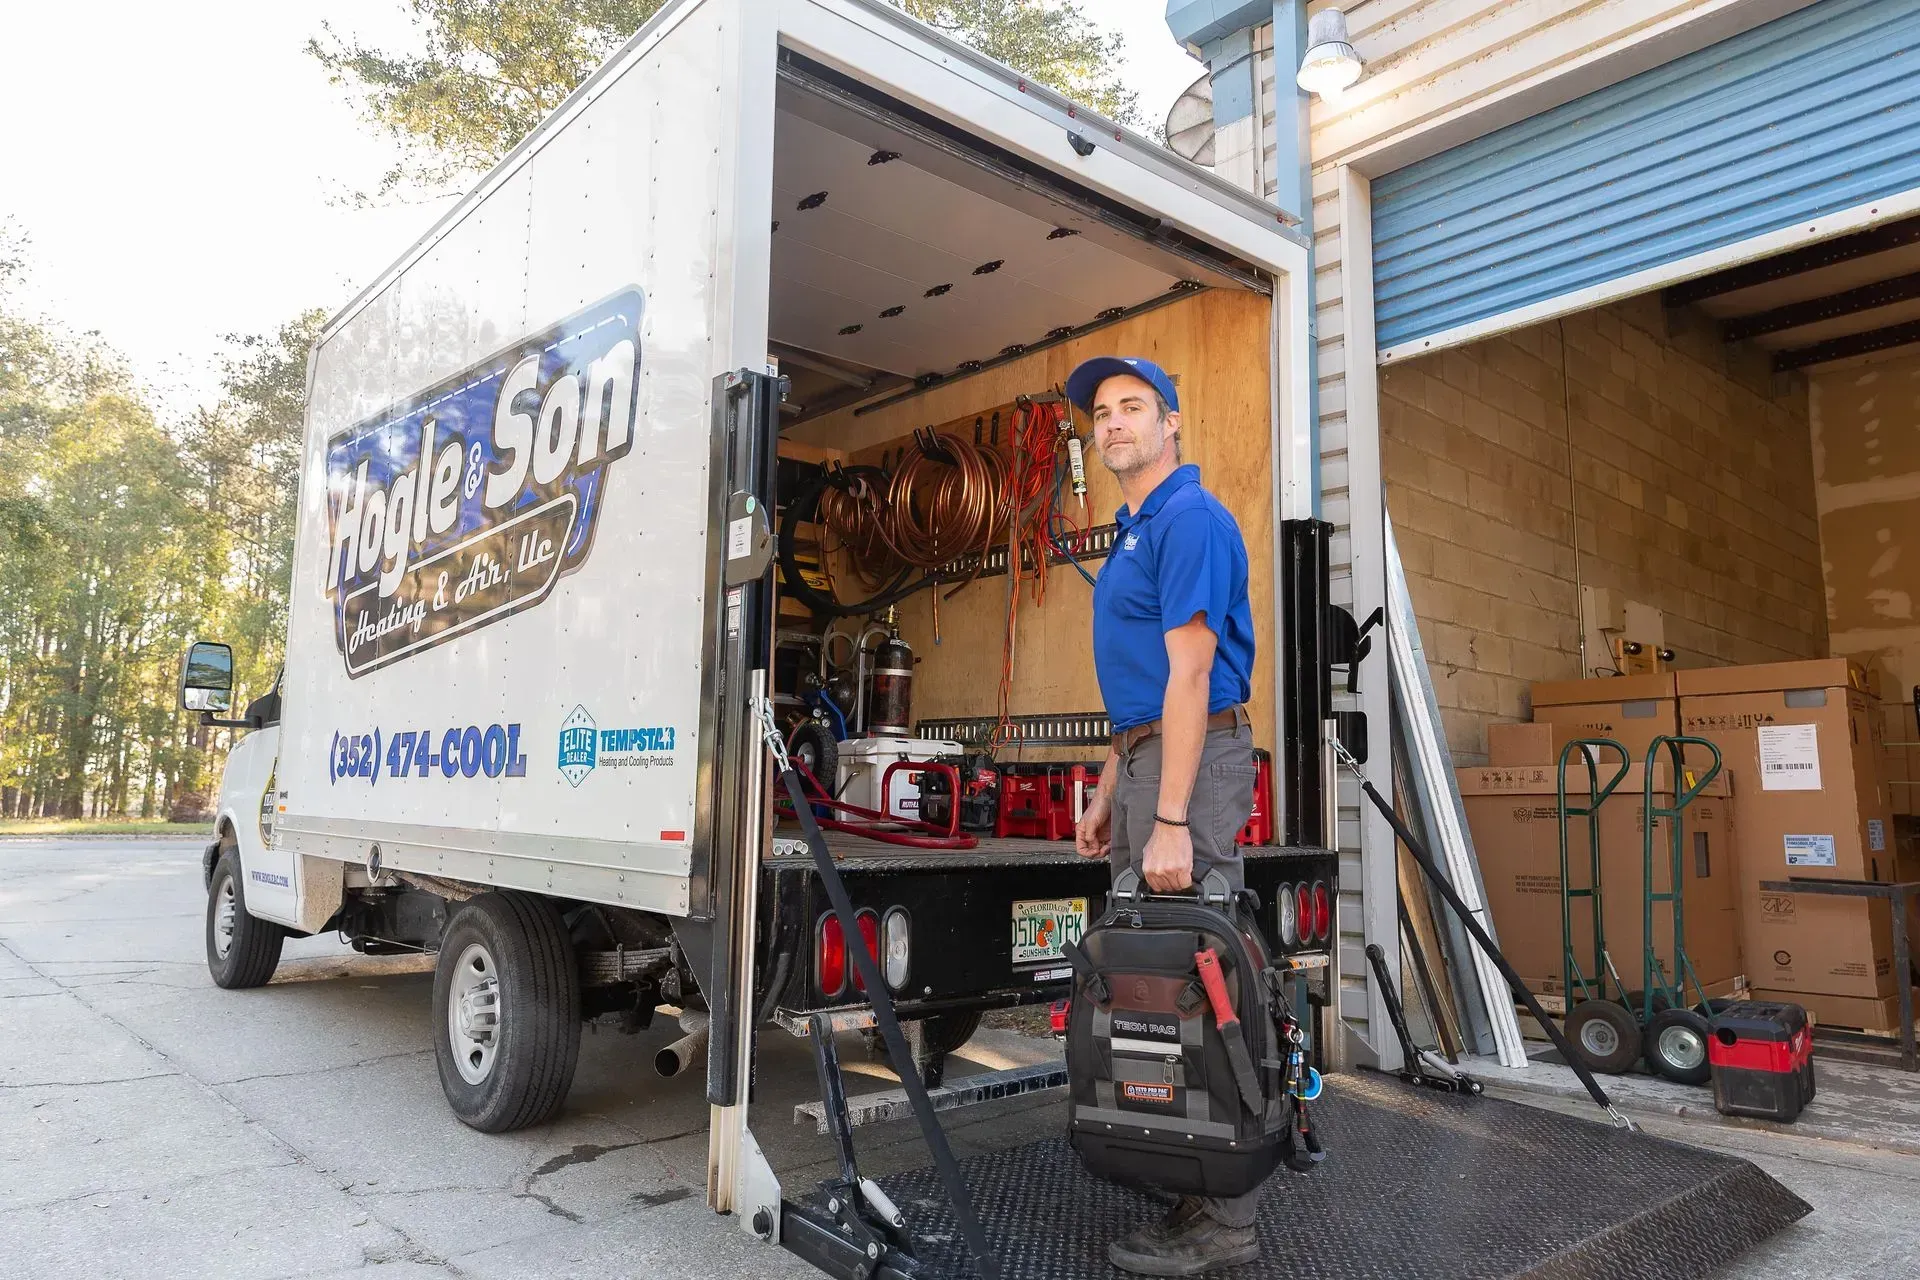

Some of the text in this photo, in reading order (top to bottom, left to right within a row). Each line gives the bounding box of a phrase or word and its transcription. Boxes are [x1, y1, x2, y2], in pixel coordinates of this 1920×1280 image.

[326, 340, 636, 598] Hogle & Son
[350, 596, 427, 655] Heating
[432, 570, 449, 611] &
[455, 552, 511, 604] Air,
[563, 728, 593, 753] ELITE
[600, 727, 675, 752] TEMPSTAR
[329, 723, 528, 787] (352) 474-COOL
[566, 751, 588, 763] DEALER
[599, 755, 674, 769] Heating and Cooling Products
[1056, 913, 1083, 944] YPK
[1022, 947, 1050, 958] SUNSHINE
[1149, 1023, 1177, 1036] PAC
